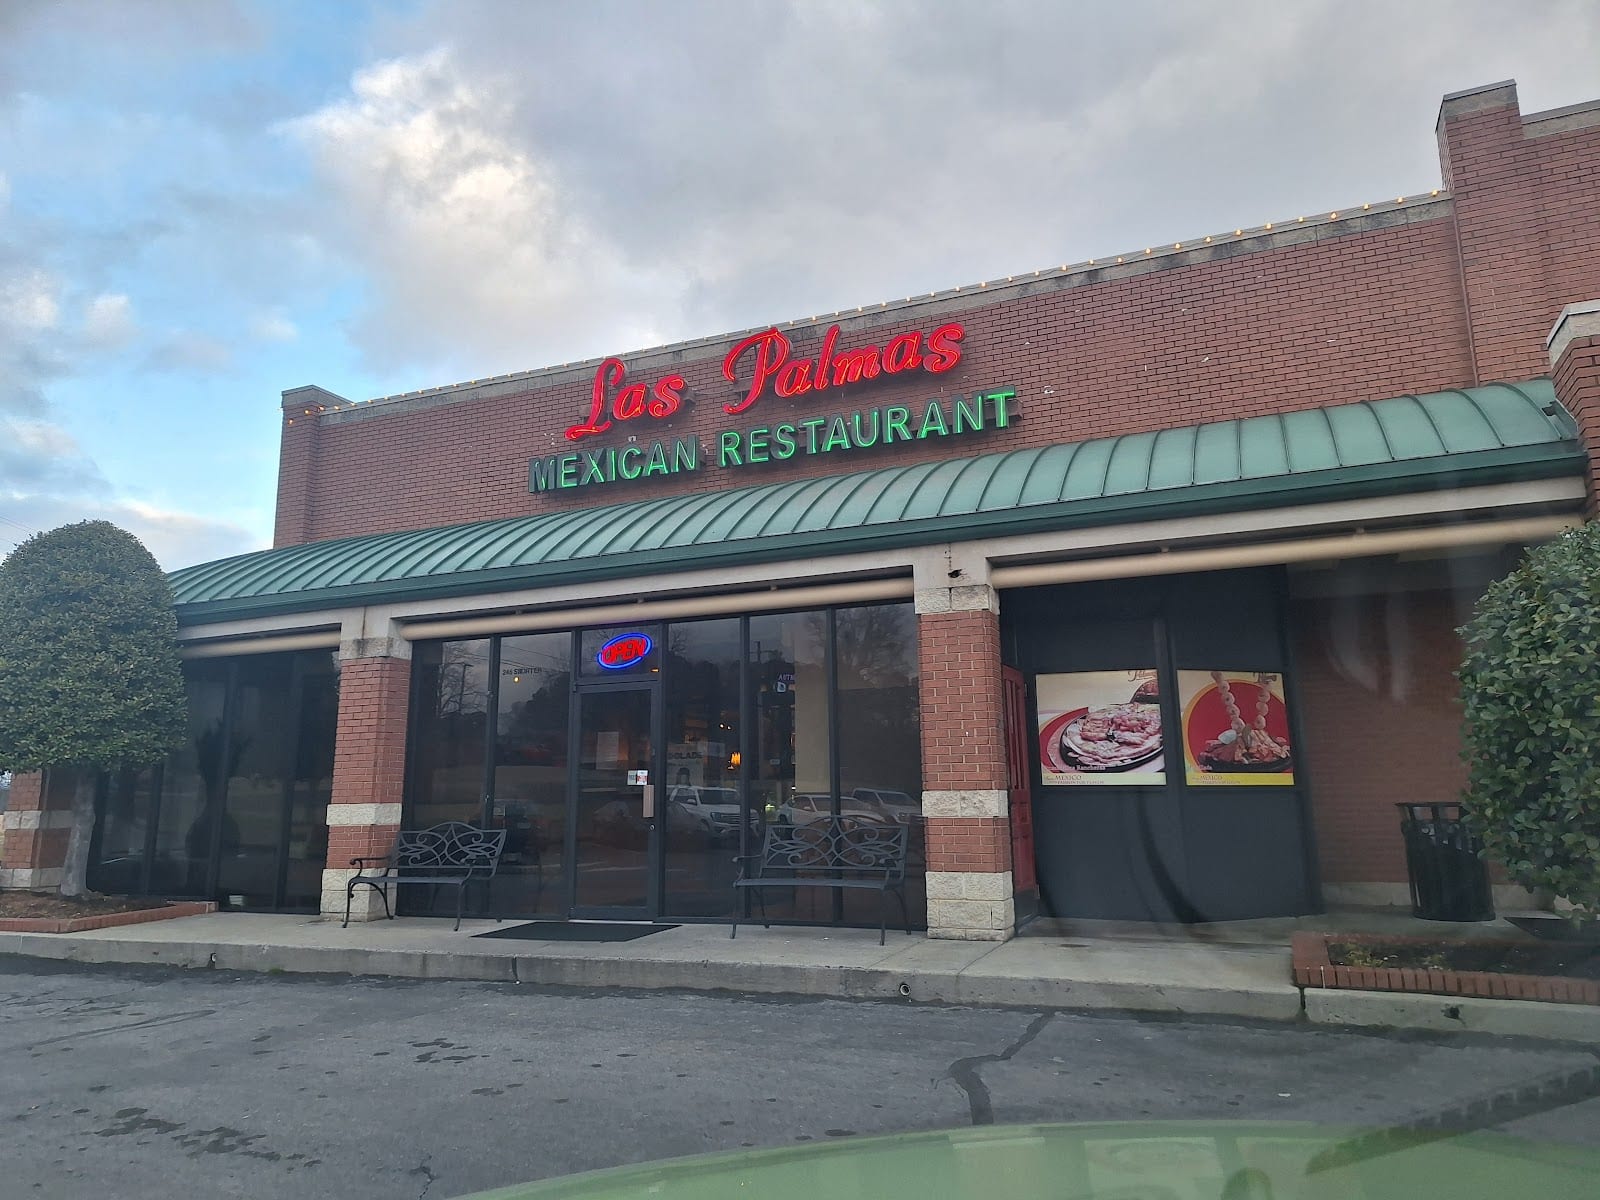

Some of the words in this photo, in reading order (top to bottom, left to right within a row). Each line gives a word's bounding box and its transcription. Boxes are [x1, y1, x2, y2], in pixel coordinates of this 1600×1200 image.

[564, 356, 688, 441] Las
[722, 324, 966, 414] Palmas
[528, 434, 699, 493] MEXICAN
[715, 384, 1016, 468] RESTAURANT
[602, 637, 647, 664] OPEN
